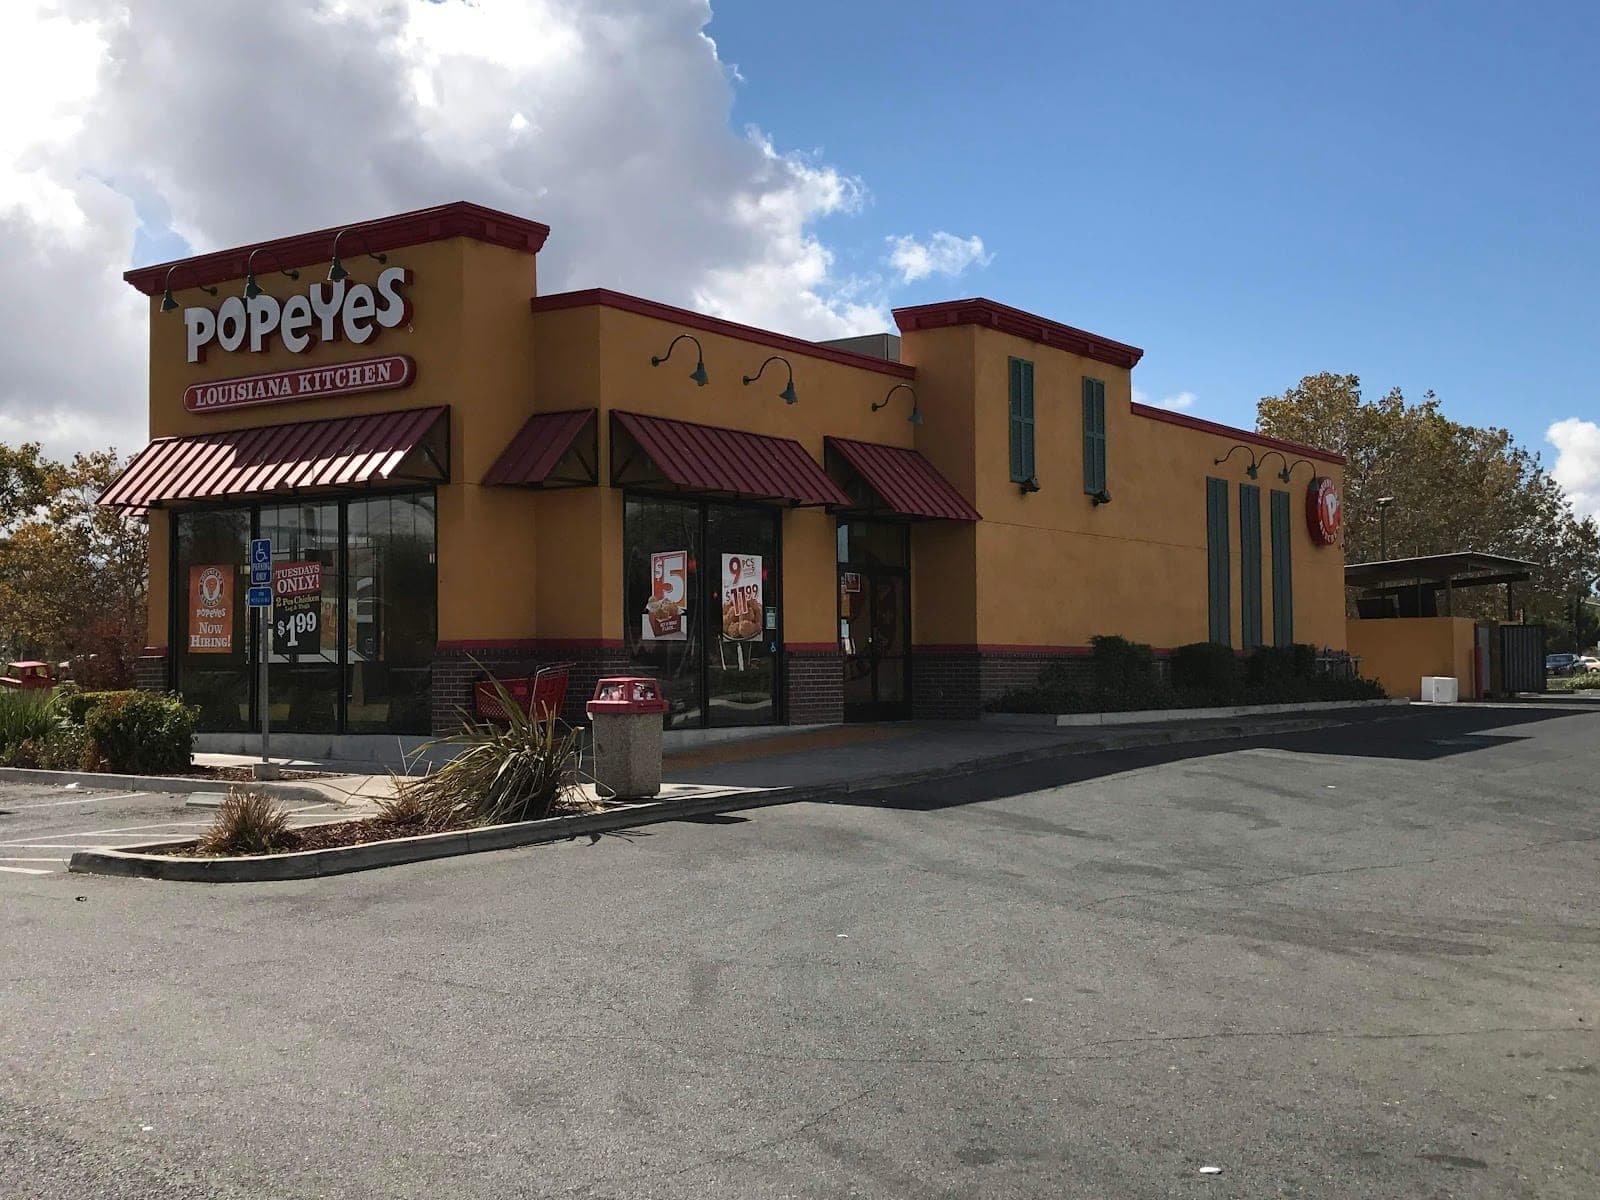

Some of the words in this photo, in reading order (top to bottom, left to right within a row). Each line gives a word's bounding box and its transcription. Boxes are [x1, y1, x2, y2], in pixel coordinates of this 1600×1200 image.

[195, 377, 292, 407] LOUISIANA
[298, 362, 392, 393] KITCHEN
[275, 564, 320, 579] TUESDAYS
[728, 556, 742, 585] 9
[276, 574, 320, 594] ONLY!
[275, 596, 282, 608] 2
